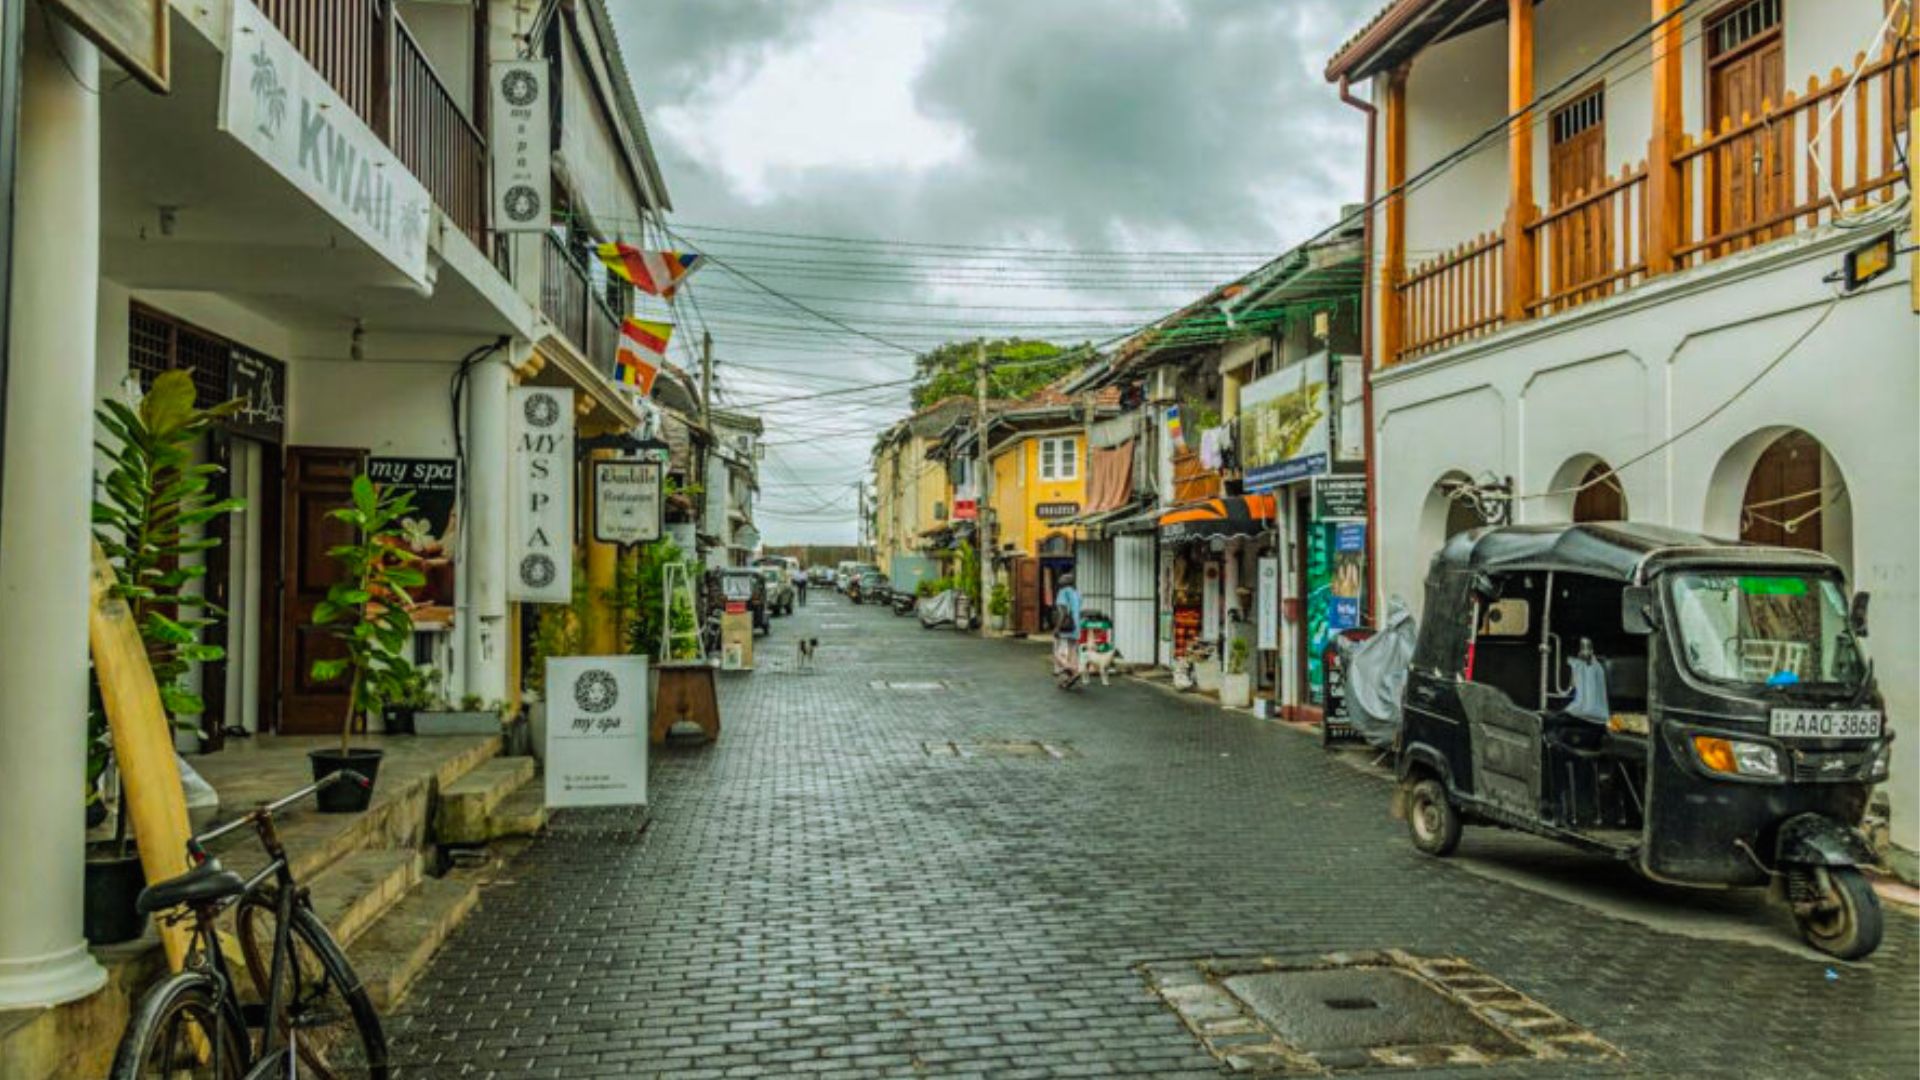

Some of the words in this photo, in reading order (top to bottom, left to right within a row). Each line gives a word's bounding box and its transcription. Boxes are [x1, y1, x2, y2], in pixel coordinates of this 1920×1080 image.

[517, 433, 564, 453] MY
[370, 461, 408, 482] my
[413, 462, 454, 482] spa
[528, 458, 550, 547] SPA
[572, 718, 594, 733] my
[597, 718, 621, 733] spa
